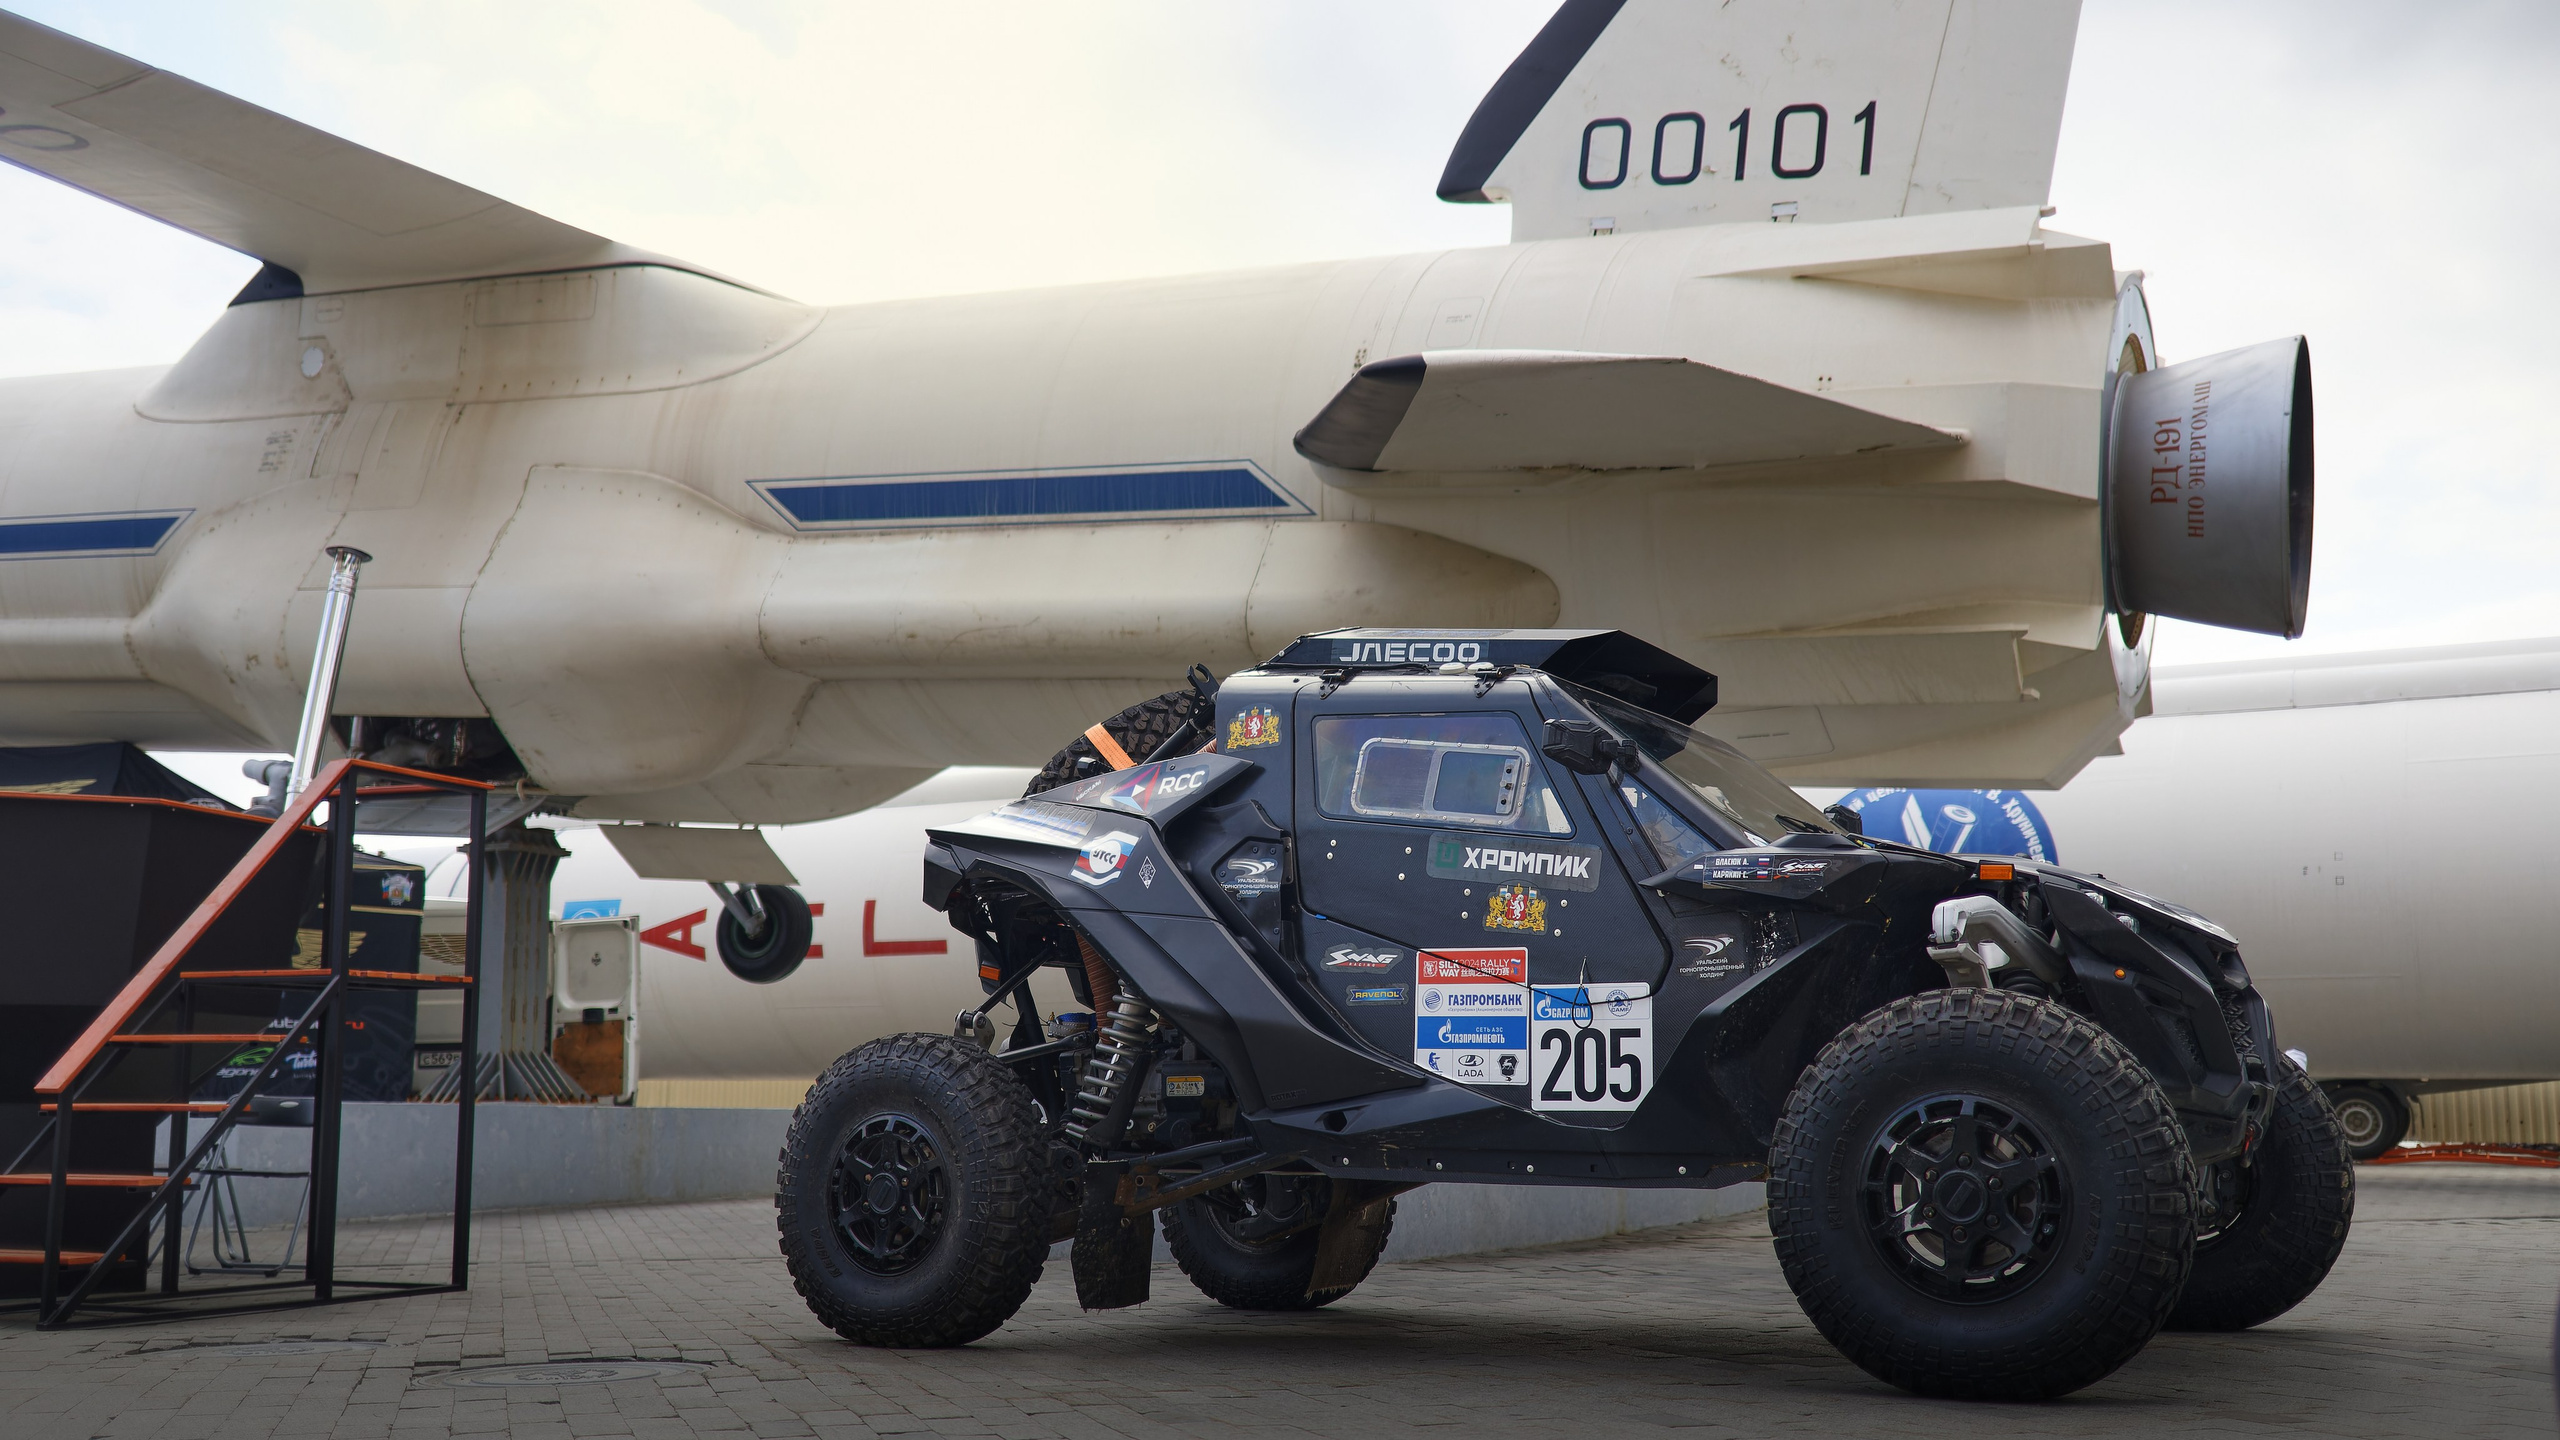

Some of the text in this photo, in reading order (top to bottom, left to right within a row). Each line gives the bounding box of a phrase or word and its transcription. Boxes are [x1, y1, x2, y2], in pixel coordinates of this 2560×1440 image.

[1578, 100, 1877, 190] 00101
[2151, 417, 2184, 504] РД-191
[2188, 380, 2212, 538] НПО ЭНЕРГОМАШ
[1338, 642, 1481, 662] JAECOO
[1157, 770, 1206, 795] RCC
[1463, 846, 1592, 879] ХРОМПИК
[1715, 858, 1749, 866] ВЛАСЮК А.
[1712, 870, 1741, 879] КАРЯКИН
[1439, 960, 1460, 969] SILK
[1480, 959, 1510, 968] RALLY
[1696, 957, 1728, 966] УРАЛЬСКИЙ
[1439, 968, 1460, 977] WAY
[1700, 971, 1725, 979] ХОЛДИНГ
[1355, 991, 1400, 999] RAVENOL
[1448, 994, 1523, 1006] ГАЗПРОМБАНК
[1451, 1033, 1505, 1044] ГАЗПРОМНЕФТЬ
[1540, 1028, 1642, 1102] 205
[1457, 1069, 1484, 1077] LADA
